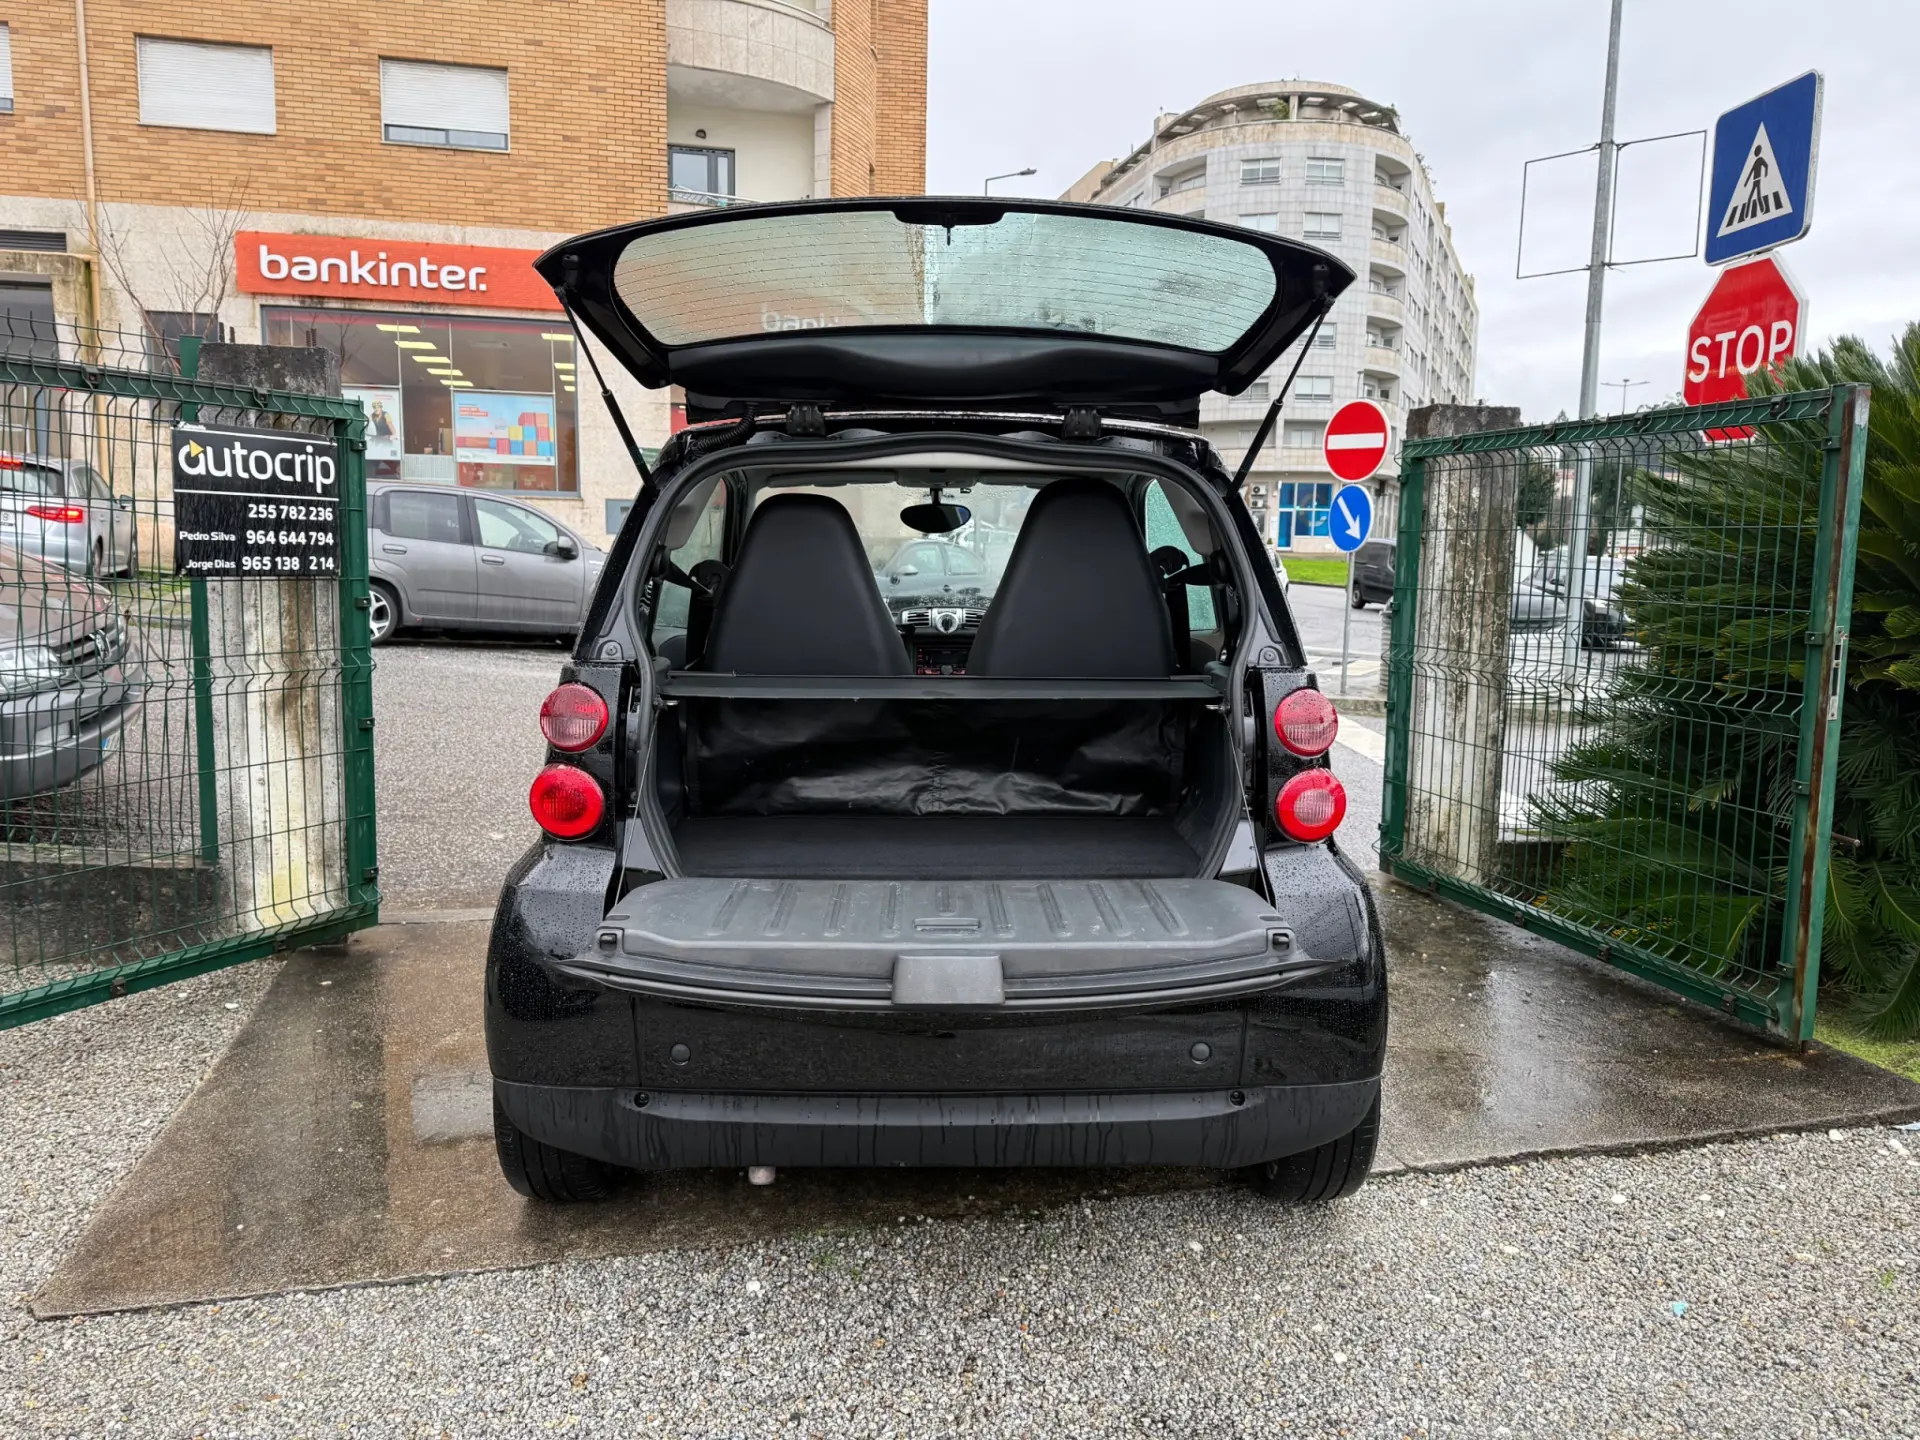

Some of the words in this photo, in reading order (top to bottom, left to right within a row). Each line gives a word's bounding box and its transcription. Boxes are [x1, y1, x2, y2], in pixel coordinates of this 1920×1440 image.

[259, 244, 487, 292] bankinter.
[1688, 320, 1794, 384] STOP
[178, 440, 336, 494] autocrip
[248, 503, 277, 519] 255
[279, 505, 307, 521] 782
[308, 507, 334, 521] 236
[179, 530, 210, 541] Pedro
[210, 531, 236, 541] Silva
[246, 530, 277, 545] 964
[278, 531, 307, 545] 644
[309, 532, 334, 546] 794
[186, 559, 214, 570] Jorge
[214, 559, 236, 569] Dias
[242, 556, 272, 570] 965
[275, 556, 300, 570] 138
[309, 556, 335, 571] 214
